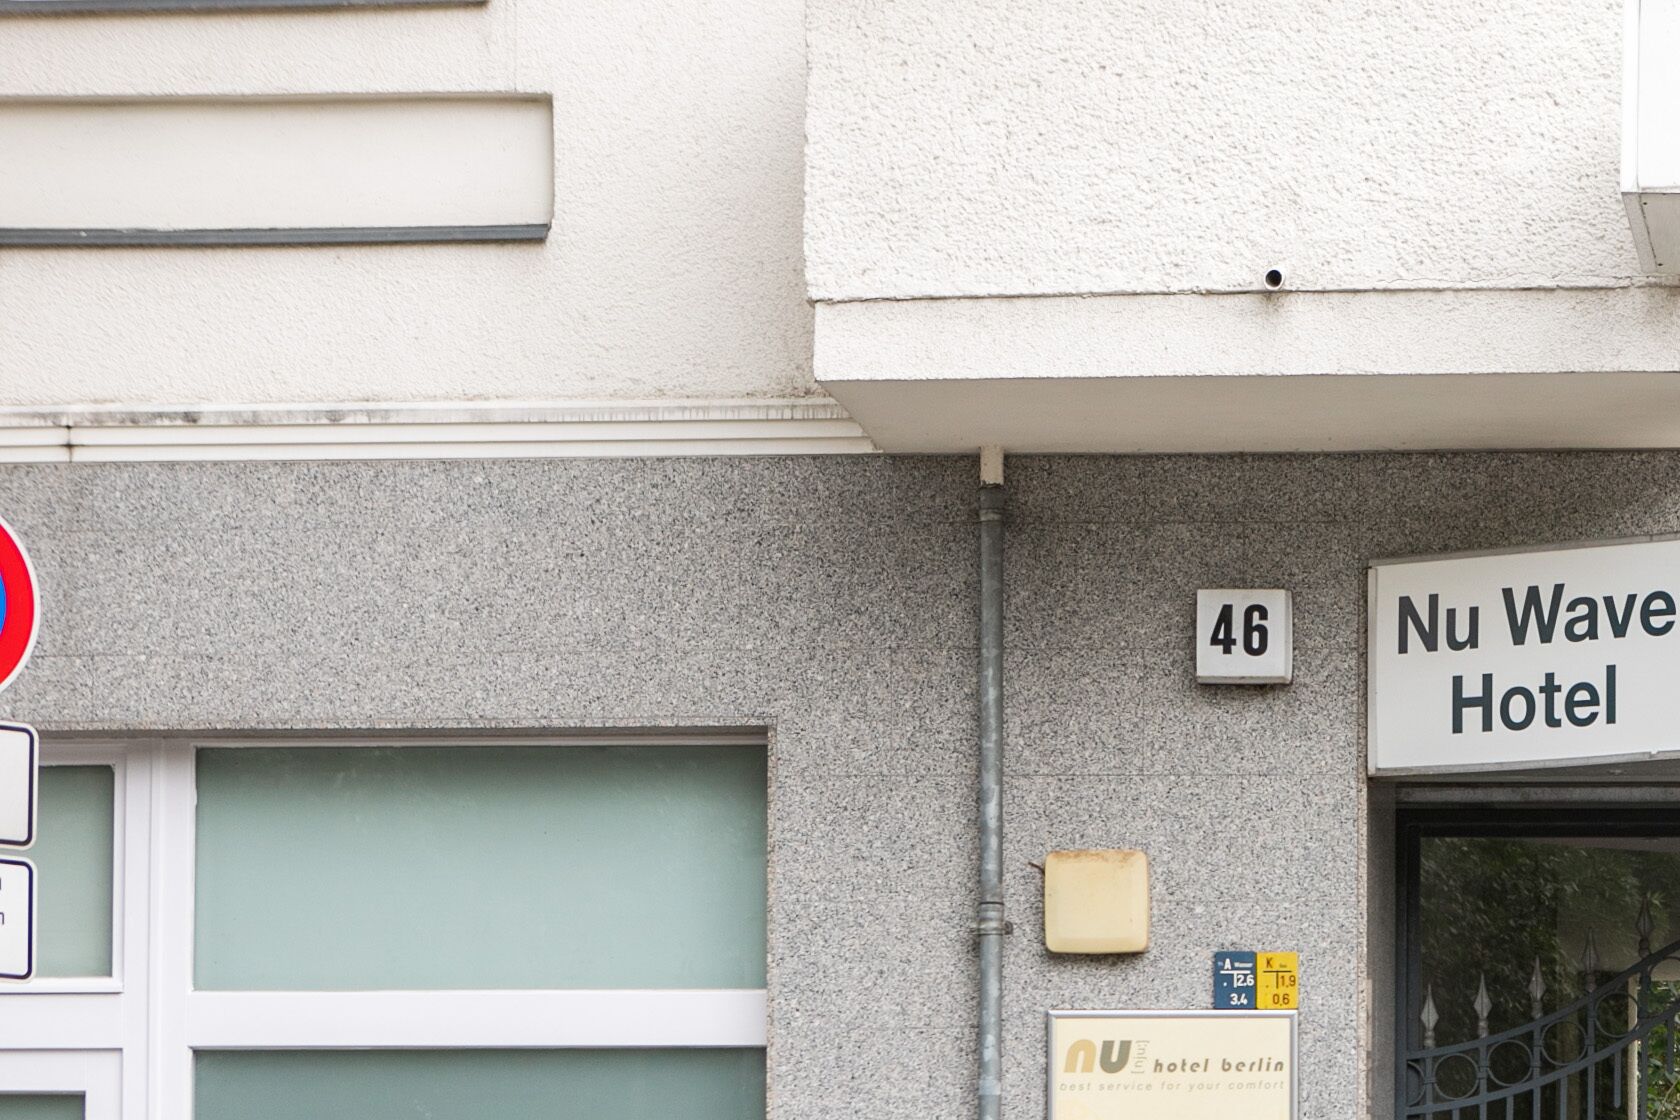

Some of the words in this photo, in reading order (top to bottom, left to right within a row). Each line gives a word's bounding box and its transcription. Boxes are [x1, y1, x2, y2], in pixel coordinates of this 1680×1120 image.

[1210, 604, 1268, 656] 46
[1398, 594, 1479, 654] Nu
[1501, 584, 1677, 646] Wave
[1452, 664, 1616, 734] Hotel
[1266, 957, 1273, 968] K
[1153, 1058, 1209, 1073] hotel
[1221, 1057, 1284, 1072] berlin
[1098, 1082, 1152, 1091] service
[1161, 1081, 1181, 1090] for
[1188, 1083, 1221, 1092] your
[1228, 1081, 1284, 1090] comfort
